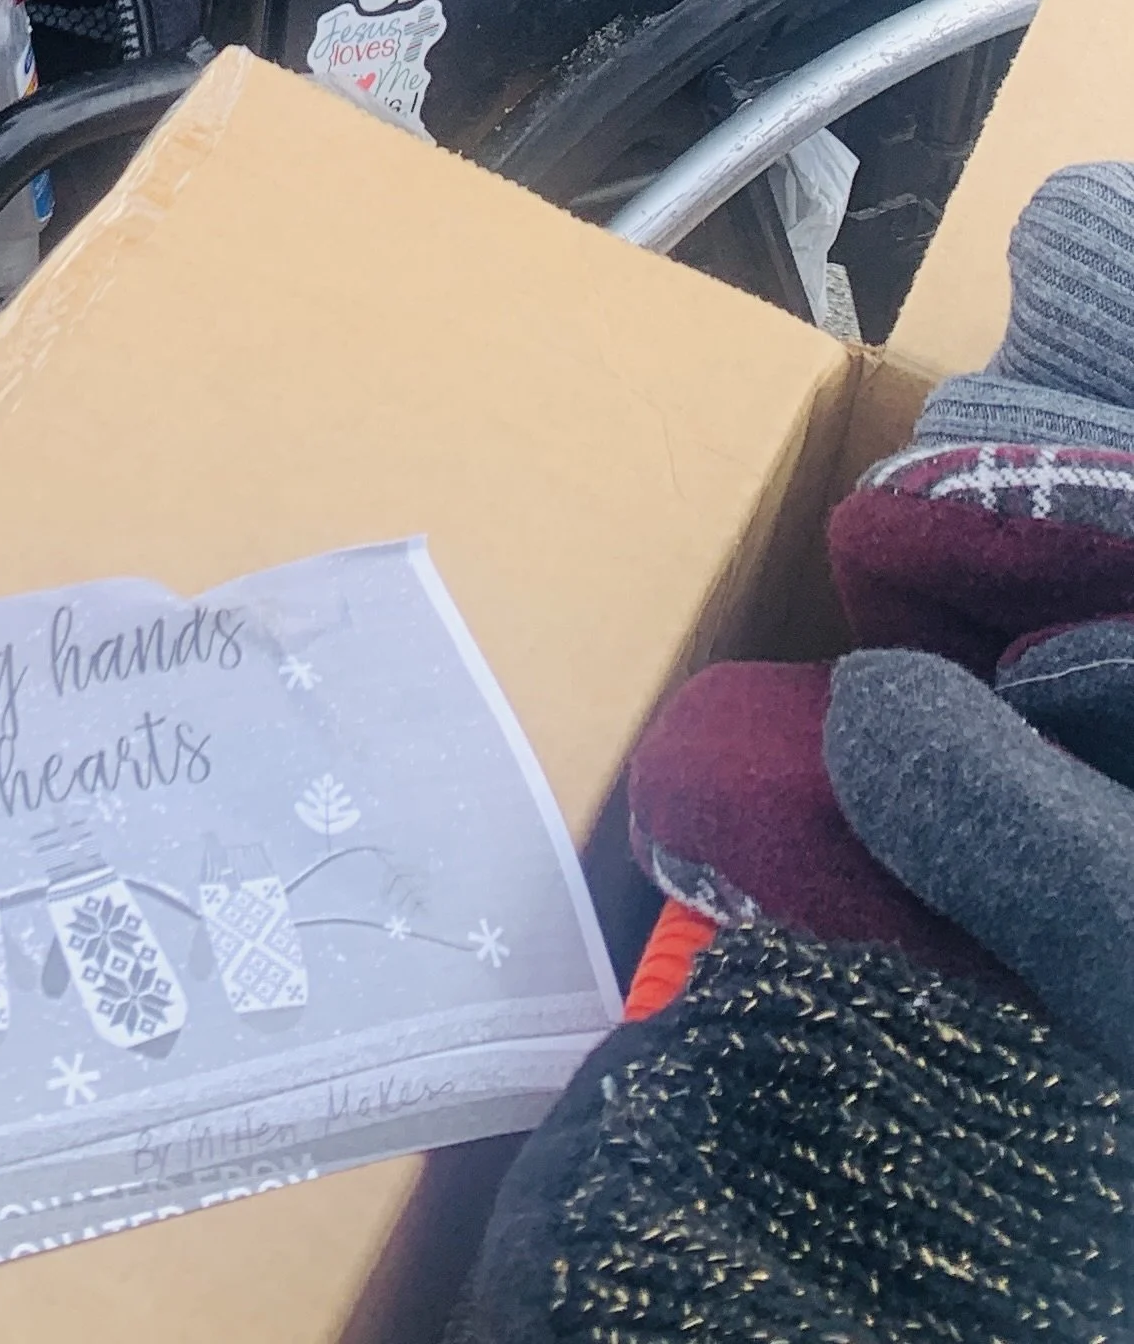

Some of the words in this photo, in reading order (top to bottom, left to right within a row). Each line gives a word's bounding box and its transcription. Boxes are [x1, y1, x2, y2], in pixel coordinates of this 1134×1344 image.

[314, 11, 402, 59] Jesus
[333, 38, 396, 66] loves
[375, 61, 425, 97] Me
[50, 604, 251, 698] hands
[132, 1124, 174, 1176] By
